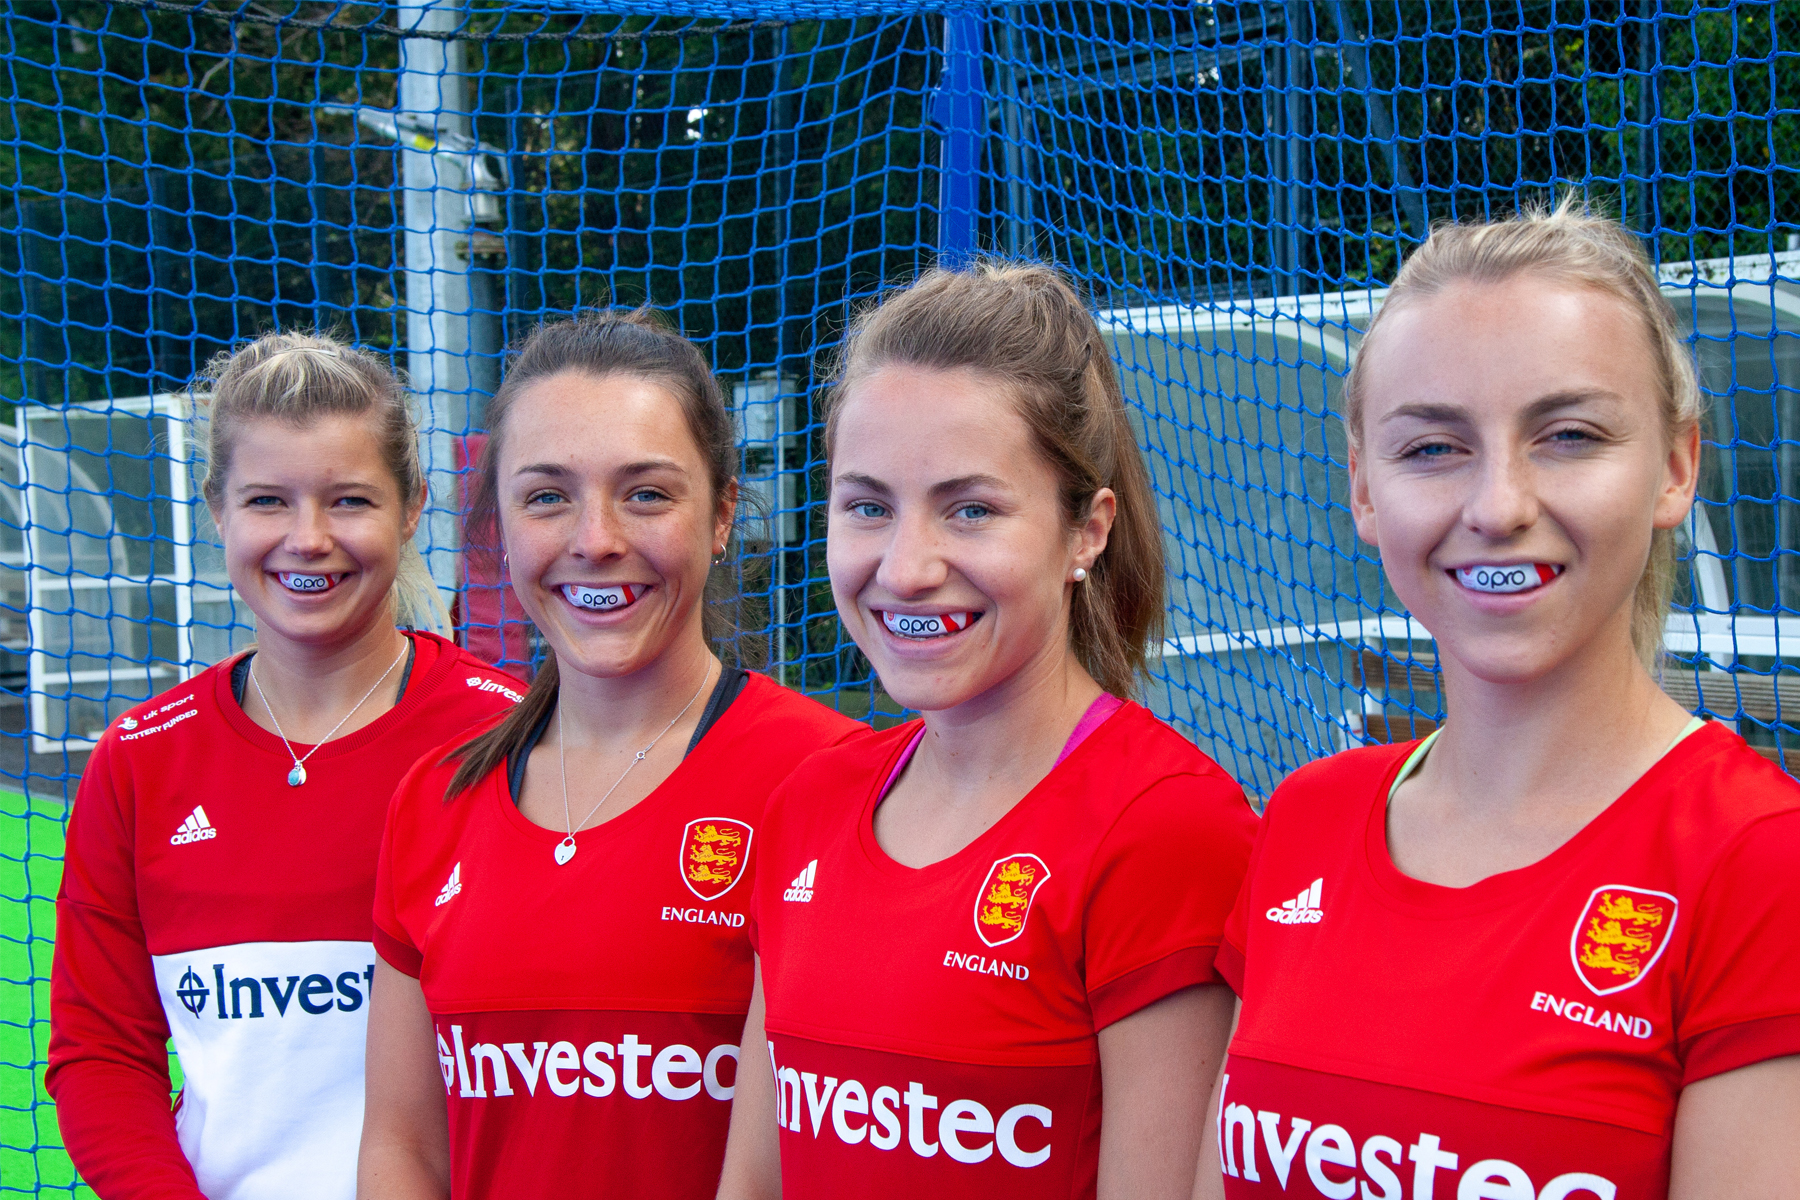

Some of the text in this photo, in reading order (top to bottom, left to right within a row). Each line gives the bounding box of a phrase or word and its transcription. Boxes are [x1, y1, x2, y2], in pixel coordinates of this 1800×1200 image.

[294, 577, 325, 590] opro
[1476, 570, 1526, 589] opro
[582, 593, 618, 607] opro
[899, 618, 940, 634] opro
[160, 693, 194, 713] sport
[119, 709, 198, 741] LOTTERY FUNDED
[170, 827, 217, 846] adidas
[434, 882, 462, 907] adidas
[783, 885, 814, 903] adidas
[661, 906, 746, 928] ENGLAND
[1266, 906, 1324, 925] adidas
[943, 950, 1030, 981] ENGLAND
[1530, 991, 1653, 1040] ENGLAND
